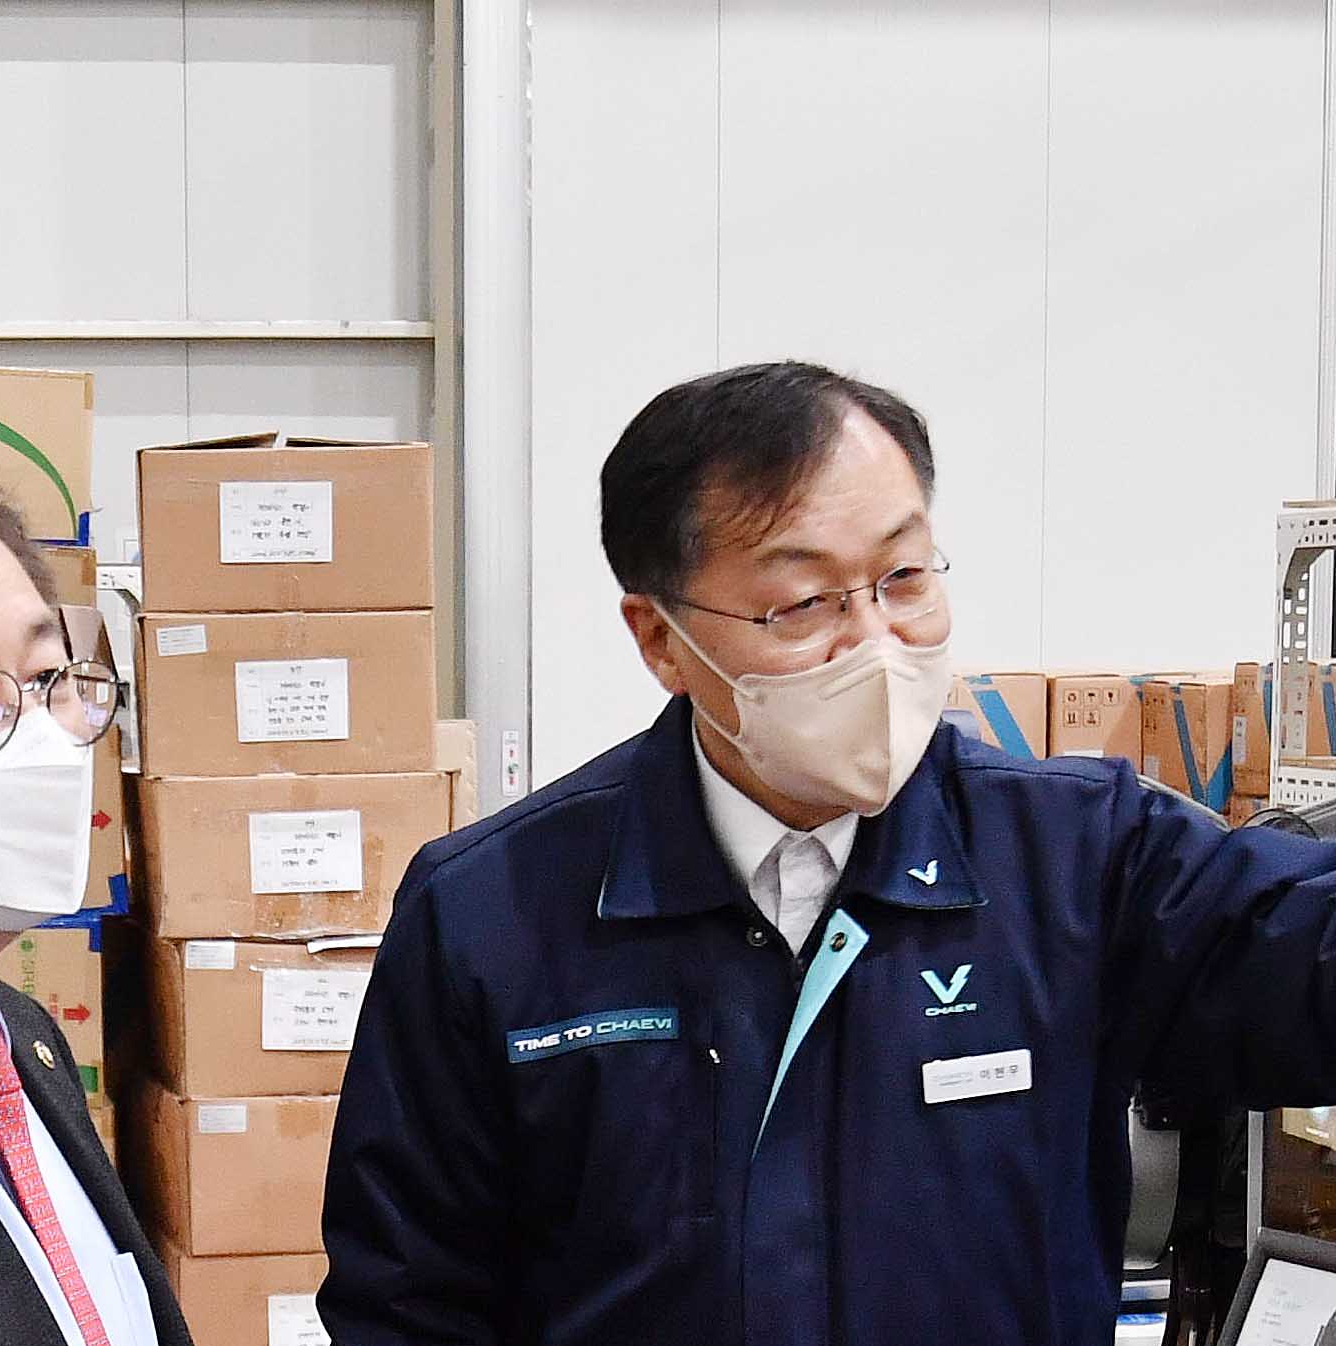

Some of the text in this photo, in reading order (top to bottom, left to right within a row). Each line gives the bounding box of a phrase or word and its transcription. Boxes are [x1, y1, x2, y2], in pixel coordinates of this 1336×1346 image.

[514, 1017, 673, 1052] TIME TO CHAEVI
